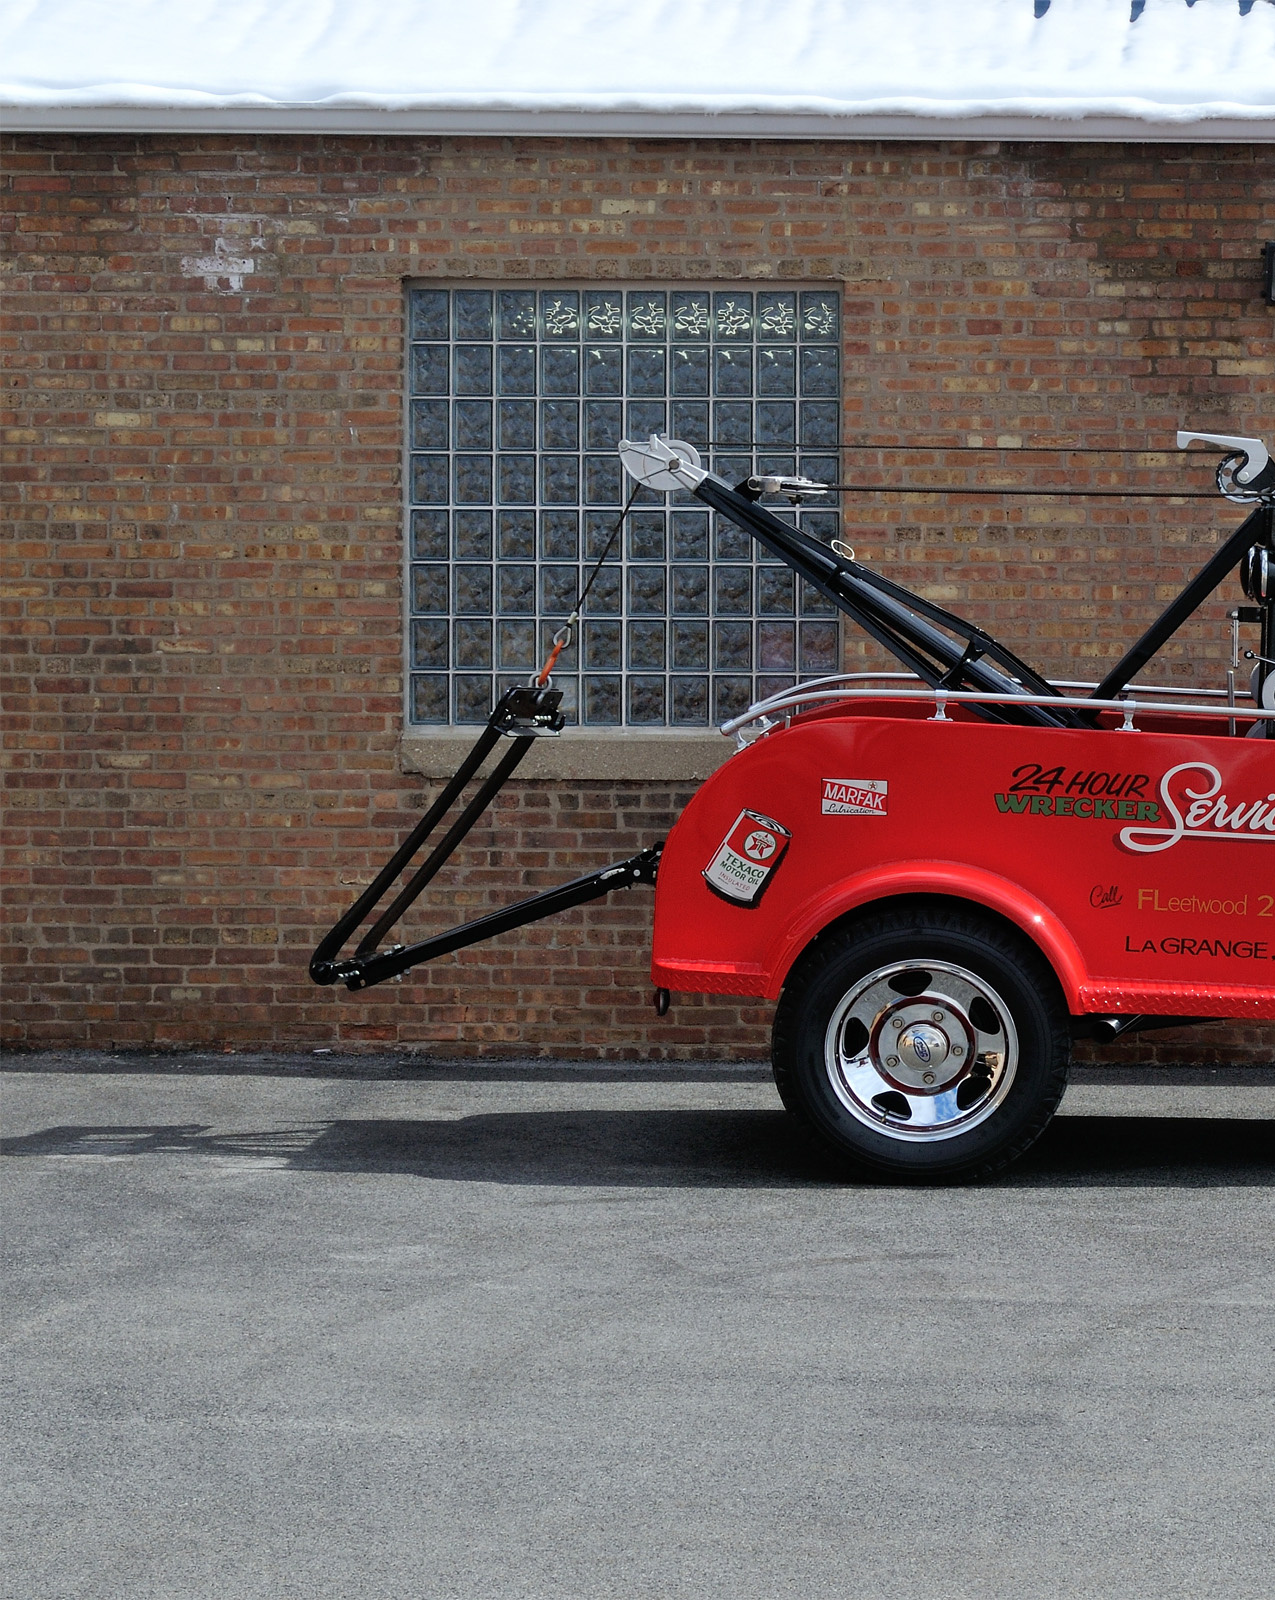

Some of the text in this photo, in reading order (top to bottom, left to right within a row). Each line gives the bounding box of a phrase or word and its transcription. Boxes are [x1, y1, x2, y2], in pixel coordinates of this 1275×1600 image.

[1010, 763, 1151, 798] 24 HOUR
[824, 783, 886, 809] MARFAK
[824, 803, 876, 814] Lubrication
[994, 793, 1162, 823] WRECKER
[720, 861, 747, 881] MOTOR
[747, 876, 759, 886] OIL
[727, 852, 765, 879] TEXACO
[719, 872, 751, 892] INSULATED
[1089, 884, 1124, 909] Call
[1137, 888, 1248, 916] FLeetwood
[1257, 894, 1274, 917] 2
